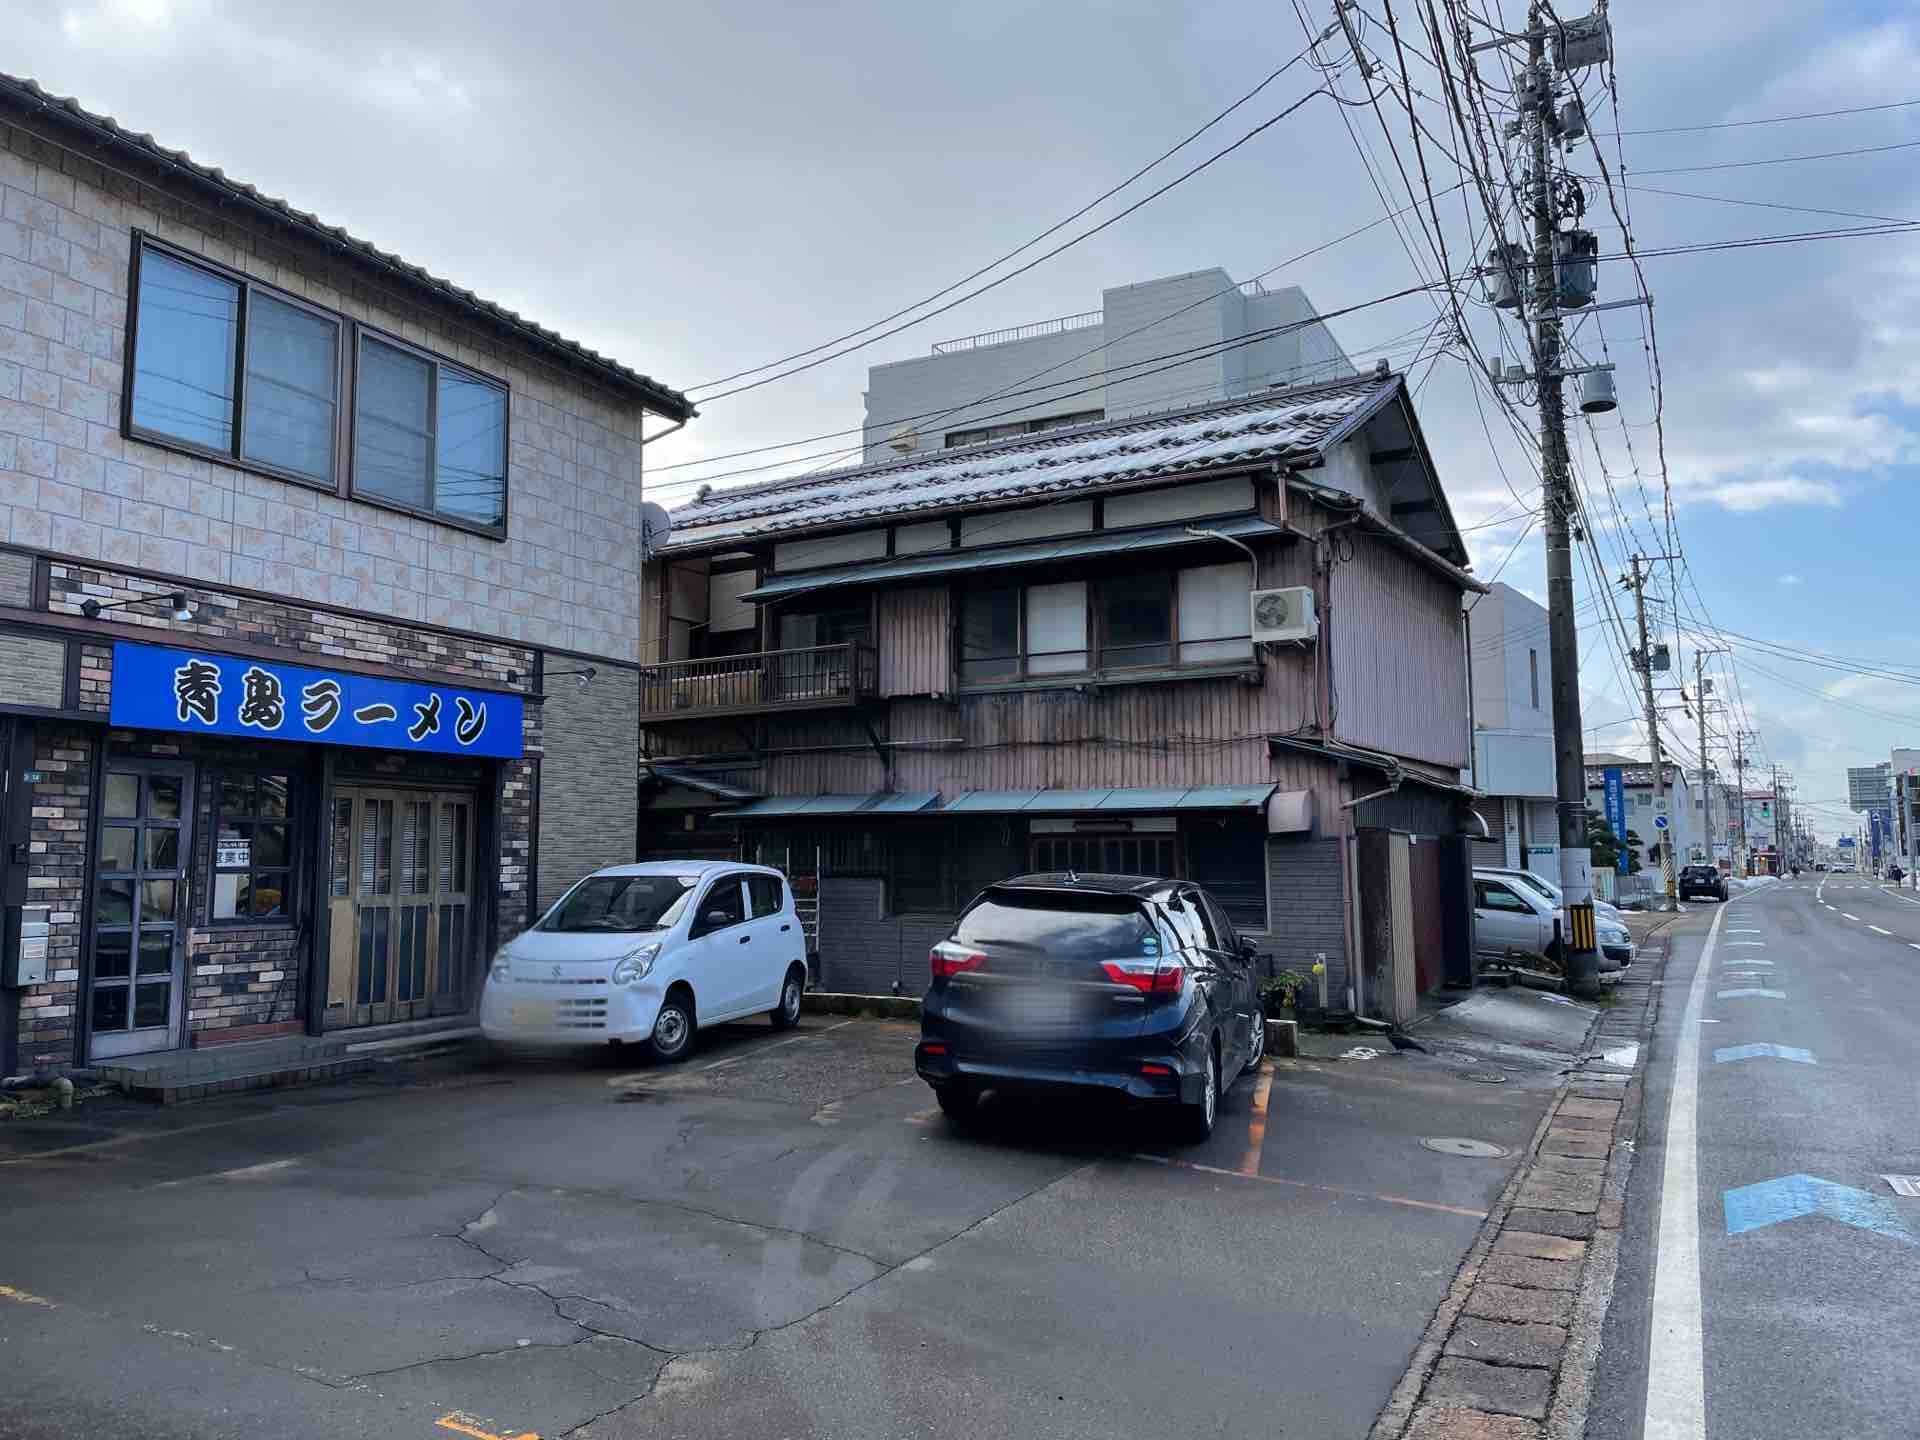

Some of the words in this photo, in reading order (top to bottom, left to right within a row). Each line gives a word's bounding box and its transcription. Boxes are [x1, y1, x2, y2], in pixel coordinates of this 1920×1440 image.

[174, 659, 487, 746] 青島ラーメン
